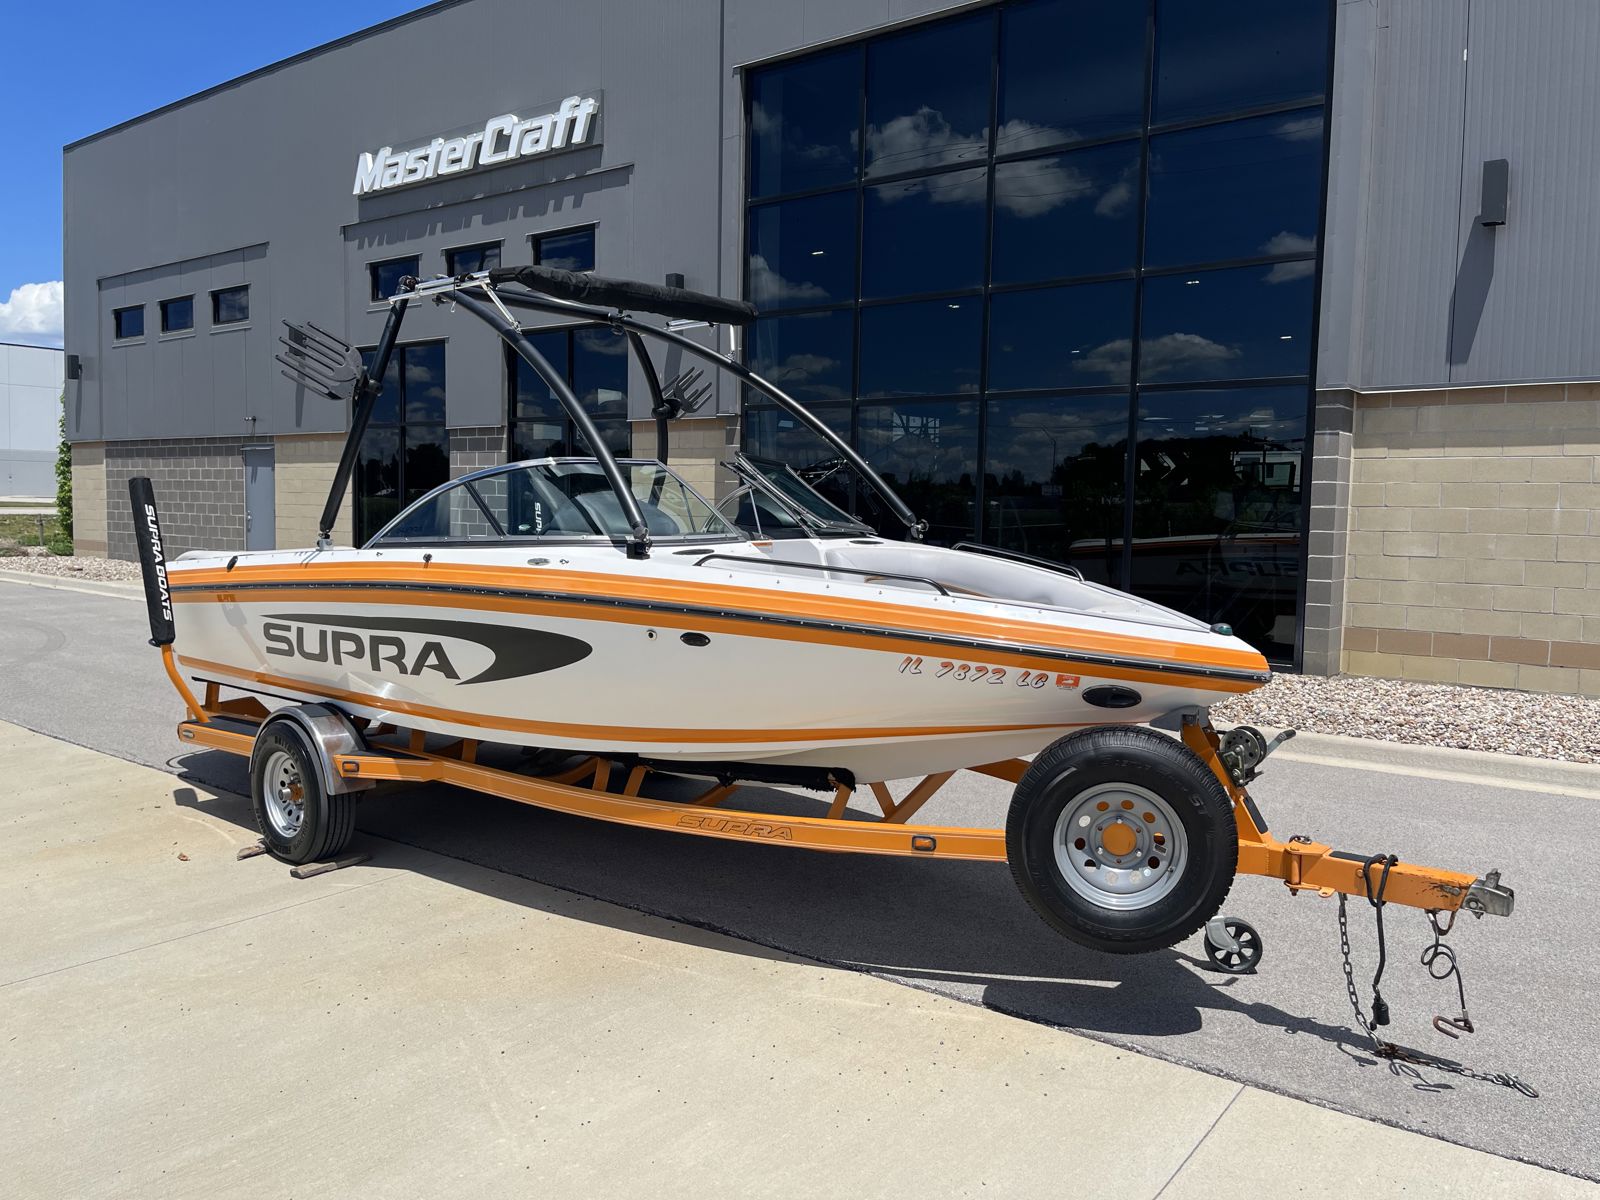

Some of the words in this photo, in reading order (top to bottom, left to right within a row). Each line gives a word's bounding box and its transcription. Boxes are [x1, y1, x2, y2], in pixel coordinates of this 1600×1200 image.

[352, 95, 599, 195] MasterCraft
[144, 503, 164, 562] SUPRA
[155, 565, 173, 622] BOATS
[263, 622, 461, 680] SUPRA
[898, 656, 923, 676] IL
[935, 661, 1007, 685] 7872
[1016, 670, 1049, 689] LC
[676, 814, 793, 840] SUPRA
